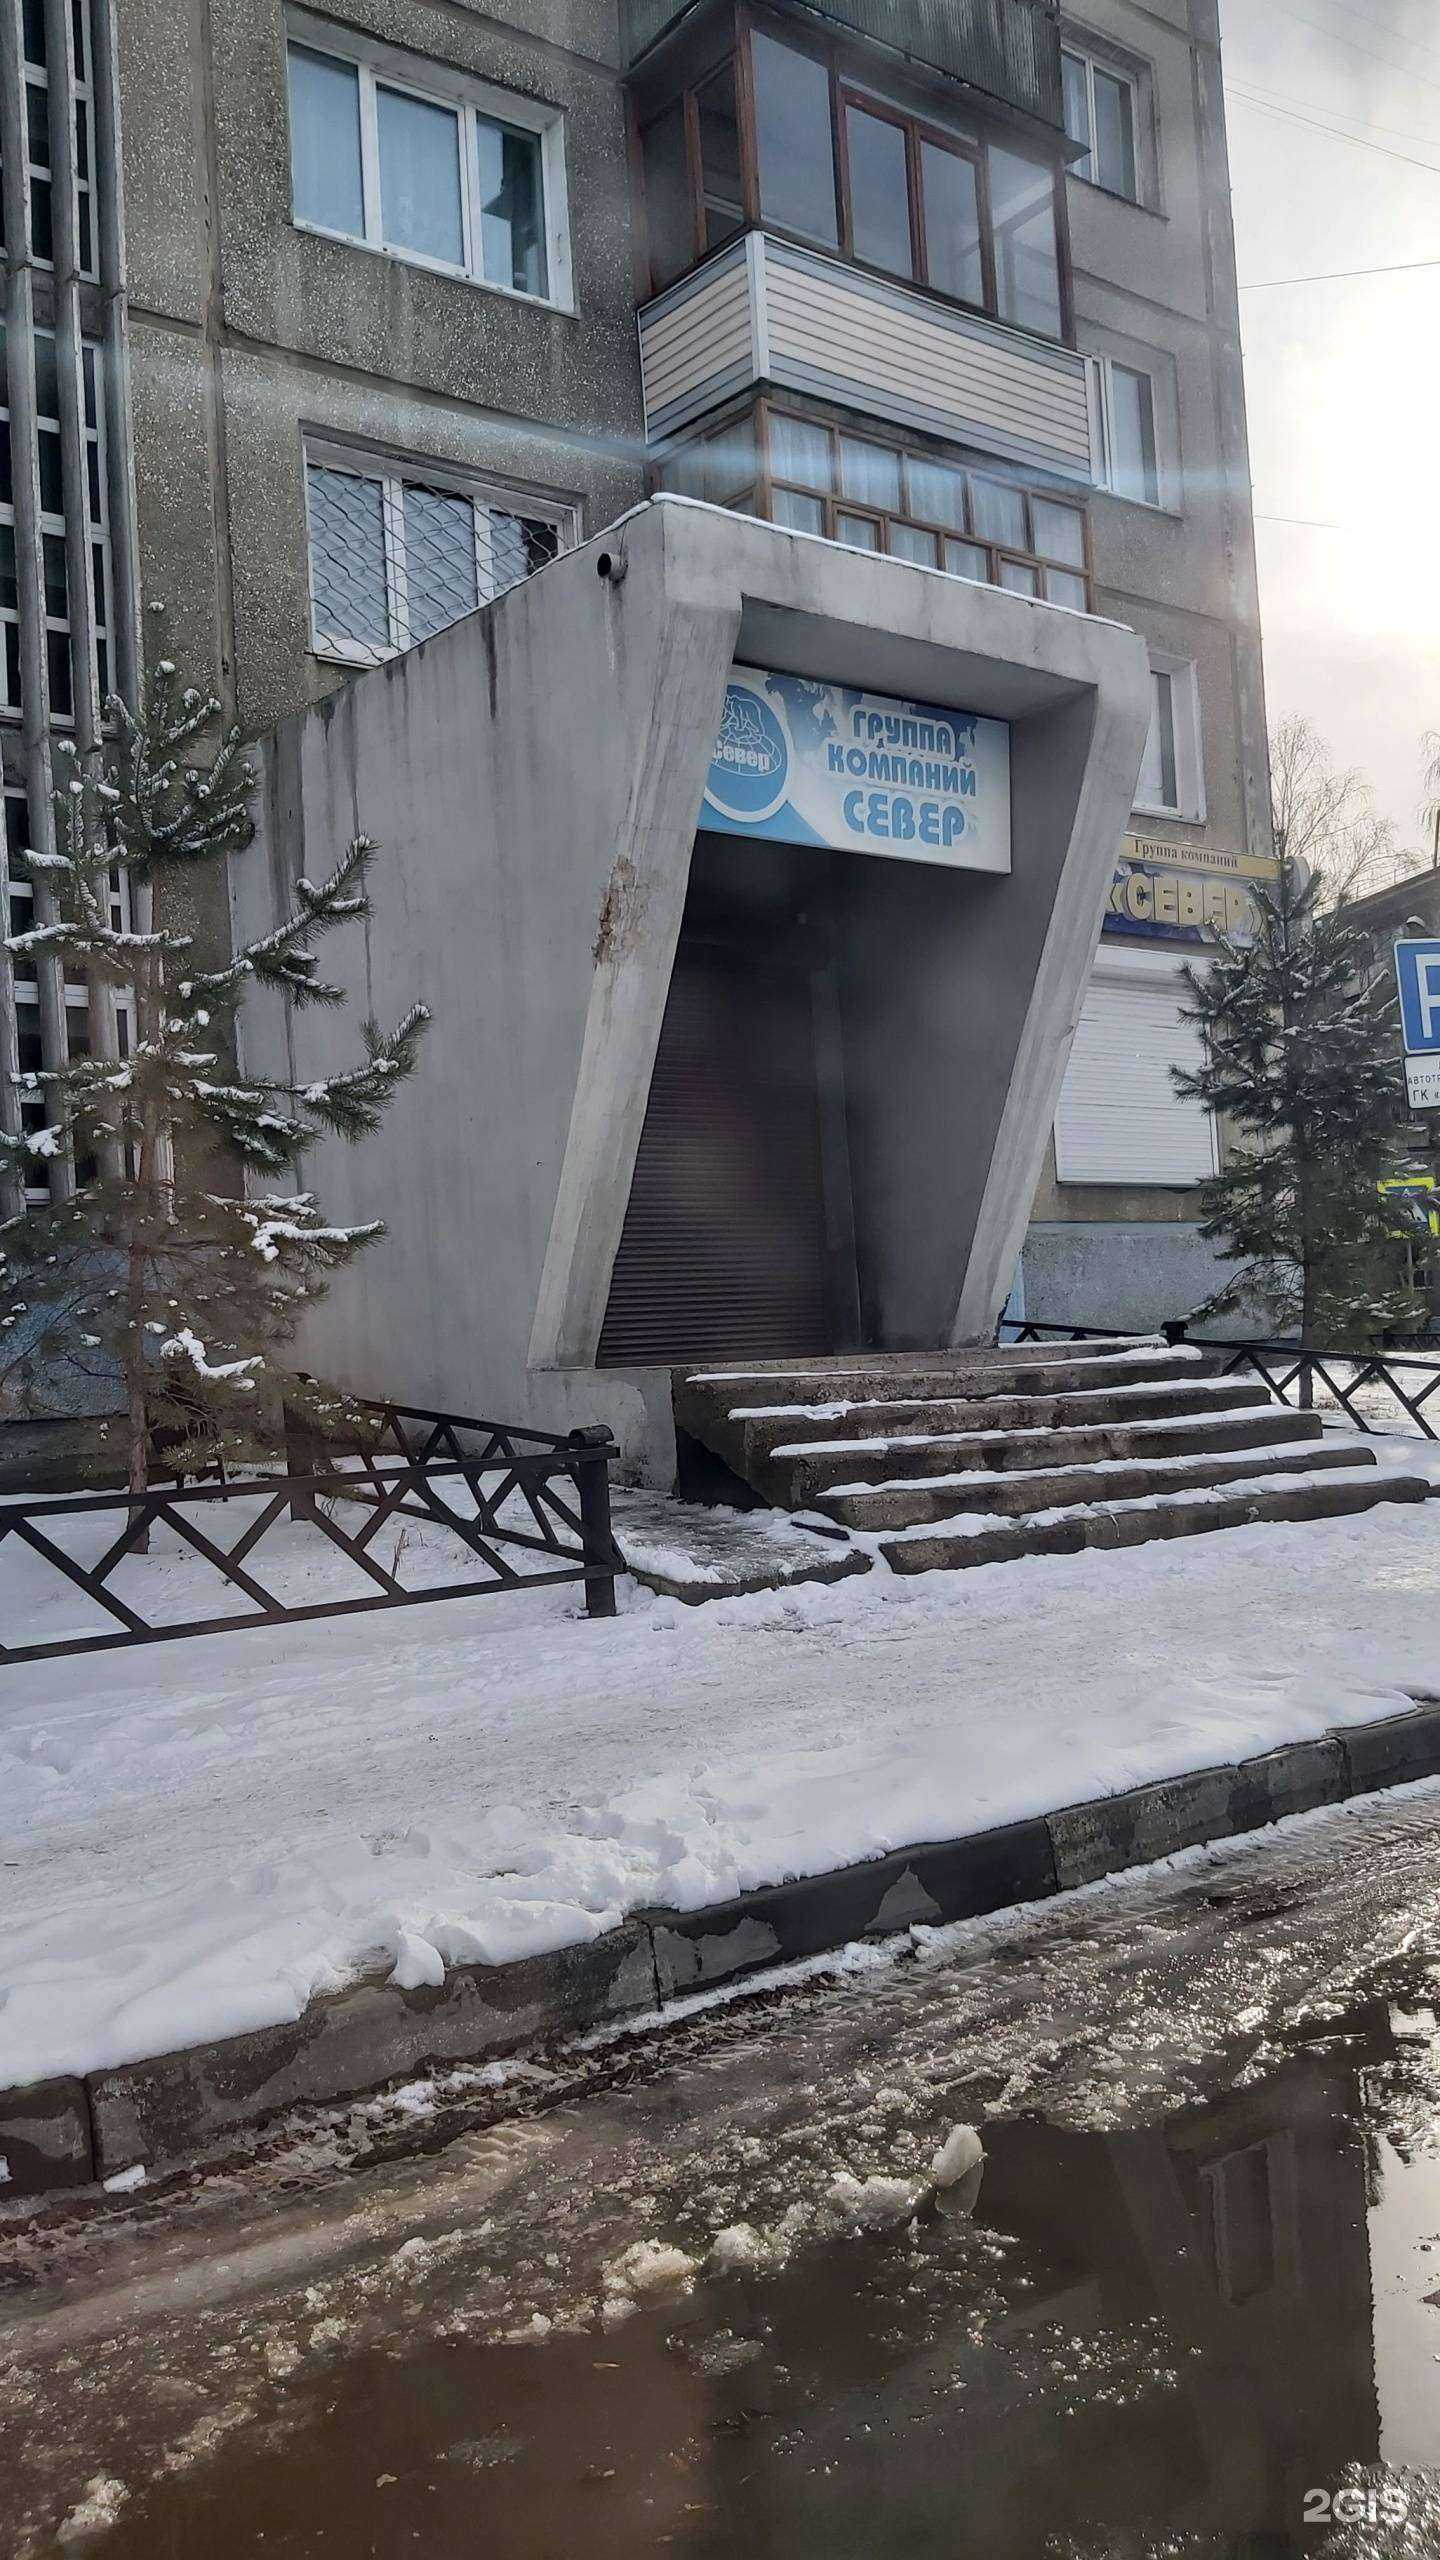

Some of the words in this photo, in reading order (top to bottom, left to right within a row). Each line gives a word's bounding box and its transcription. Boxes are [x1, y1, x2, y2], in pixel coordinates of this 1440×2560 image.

[853, 710, 953, 755] ГРУППА
[827, 742, 977, 797] КОМПАНИЙ
[842, 789, 966, 847] СЕВЕР
[1134, 839, 1178, 859] Группа
[1181, 849, 1239, 869] компаний
[1412, 1089, 1429, 1102] ГК
